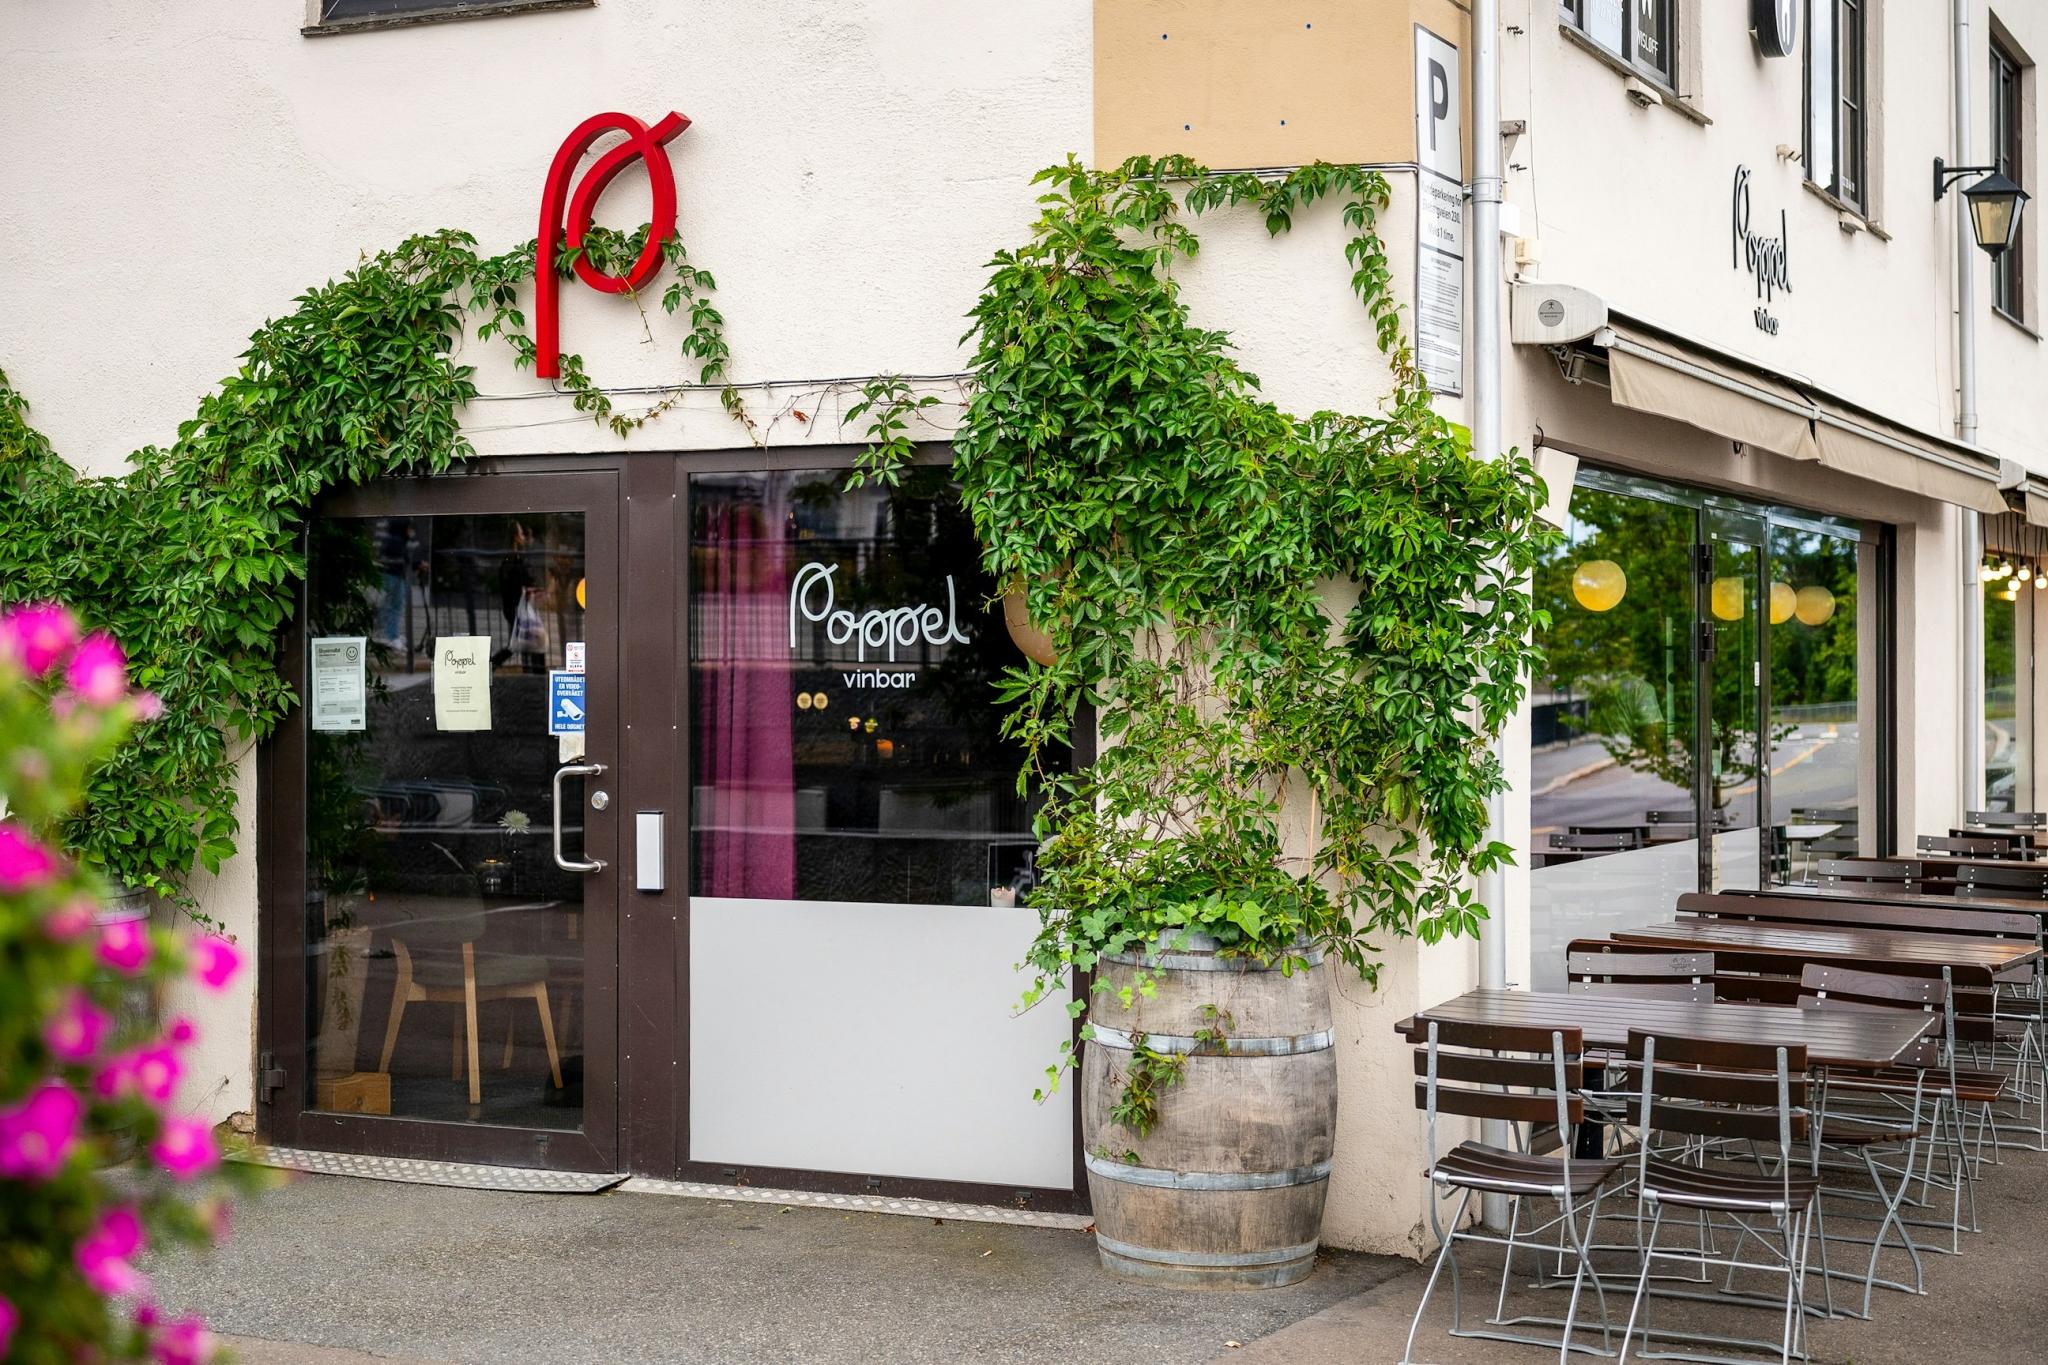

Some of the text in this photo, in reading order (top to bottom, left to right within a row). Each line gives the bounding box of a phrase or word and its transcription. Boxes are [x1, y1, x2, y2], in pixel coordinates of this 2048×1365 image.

[1428, 57, 1448, 151] P
[1732, 164, 1792, 303] Poppel
[1754, 306, 1779, 336] vinbar
[789, 562, 971, 662] Poppel
[445, 650, 476, 668] Poppel
[557, 689, 583, 697] OVERVÅKET
[843, 669, 916, 688] vinbar
